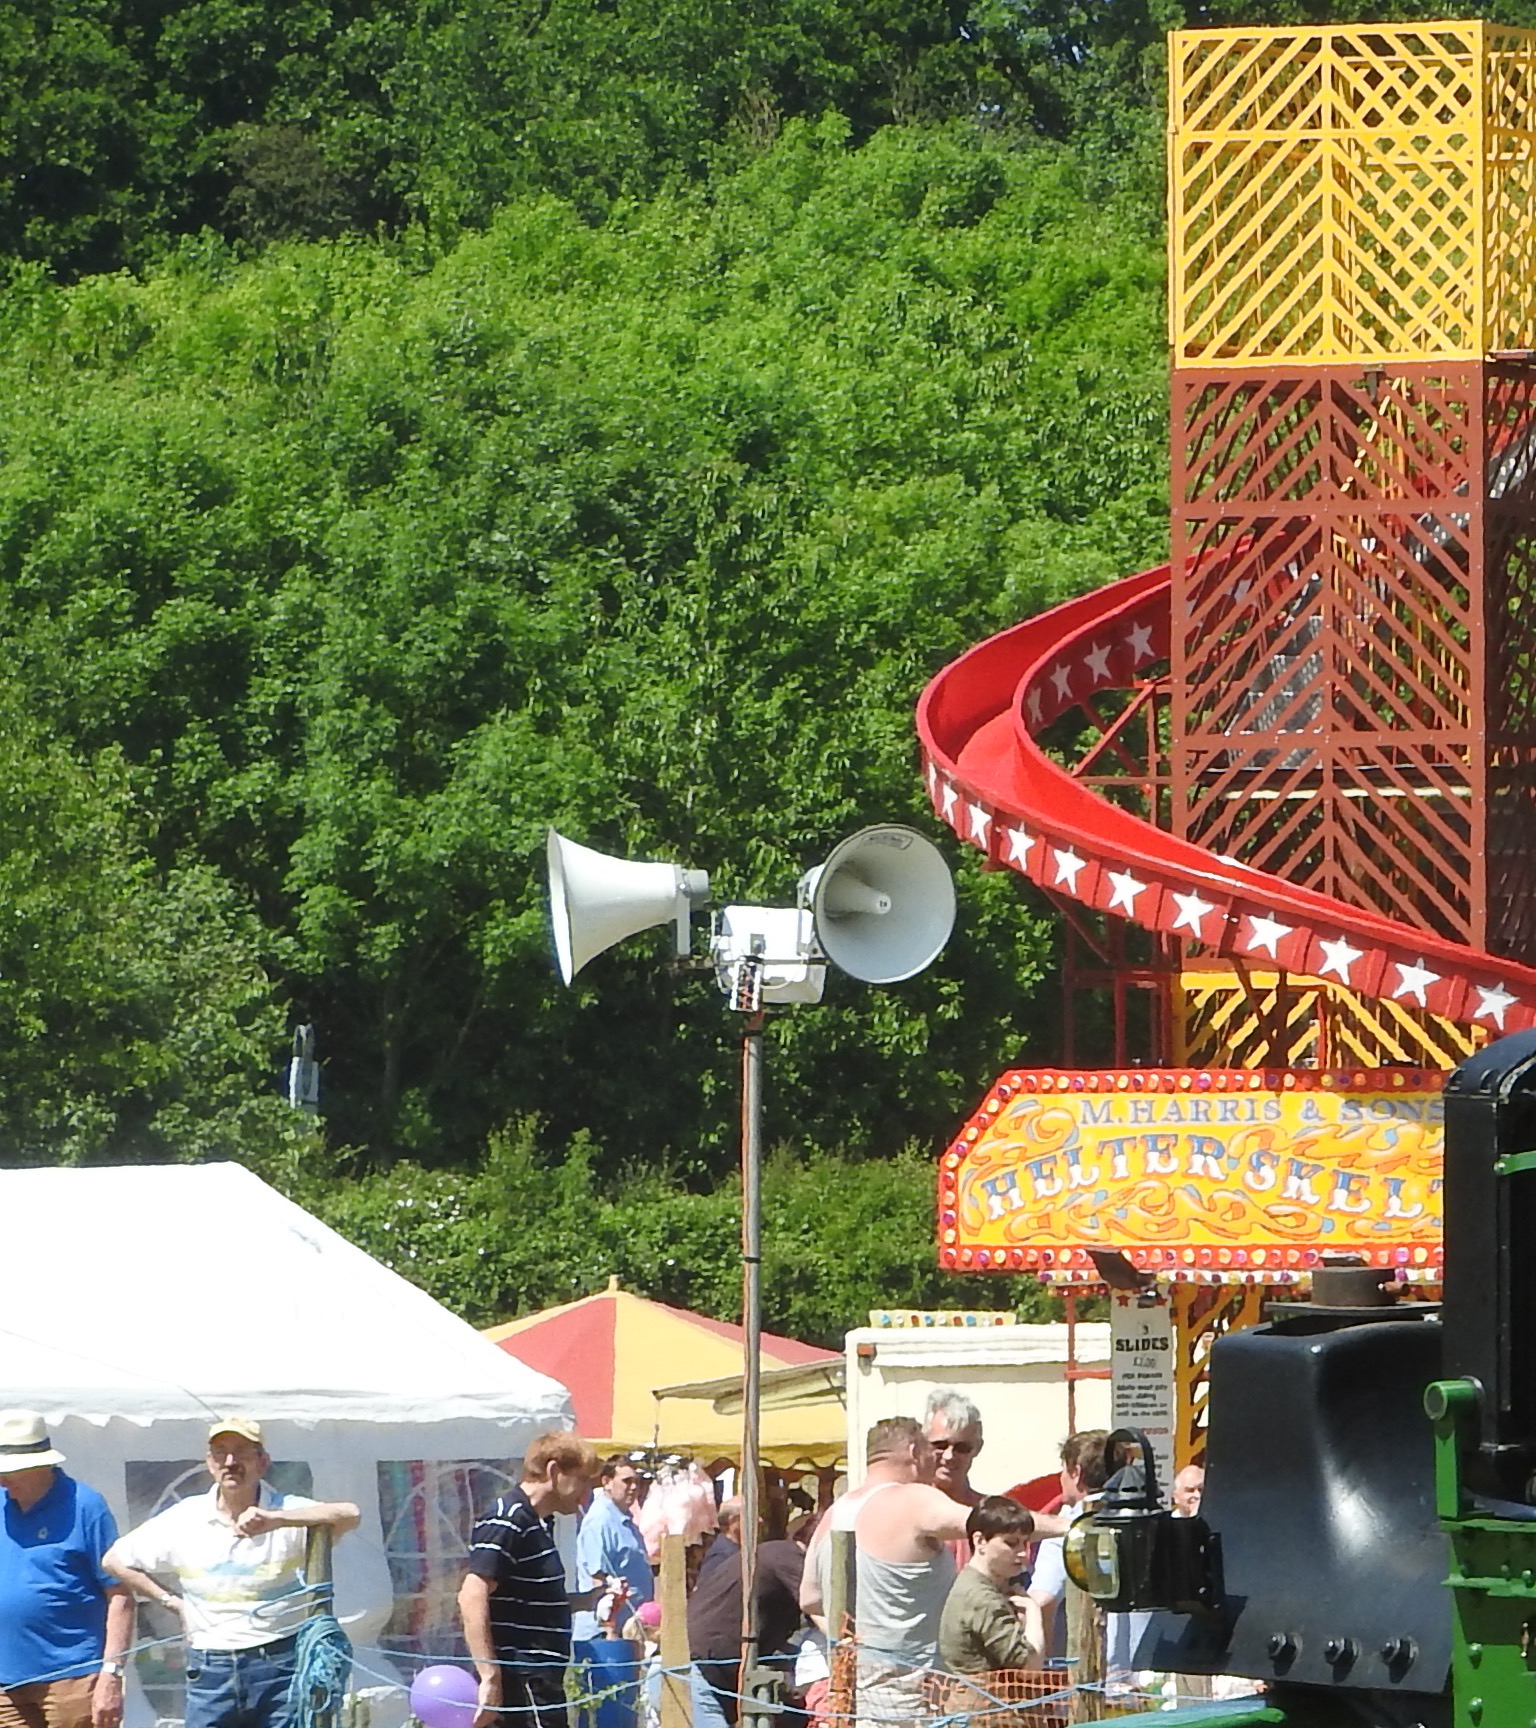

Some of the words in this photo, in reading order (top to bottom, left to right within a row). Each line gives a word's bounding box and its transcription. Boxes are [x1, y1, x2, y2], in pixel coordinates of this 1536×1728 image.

[1300, 1098, 1327, 1122] &
[1339, 1098, 1444, 1122] SONS
[980, 1132, 1229, 1222] HELTER
[1242, 1149, 1444, 1219] SKEL
[1115, 1336, 1169, 1352] SLIDES
